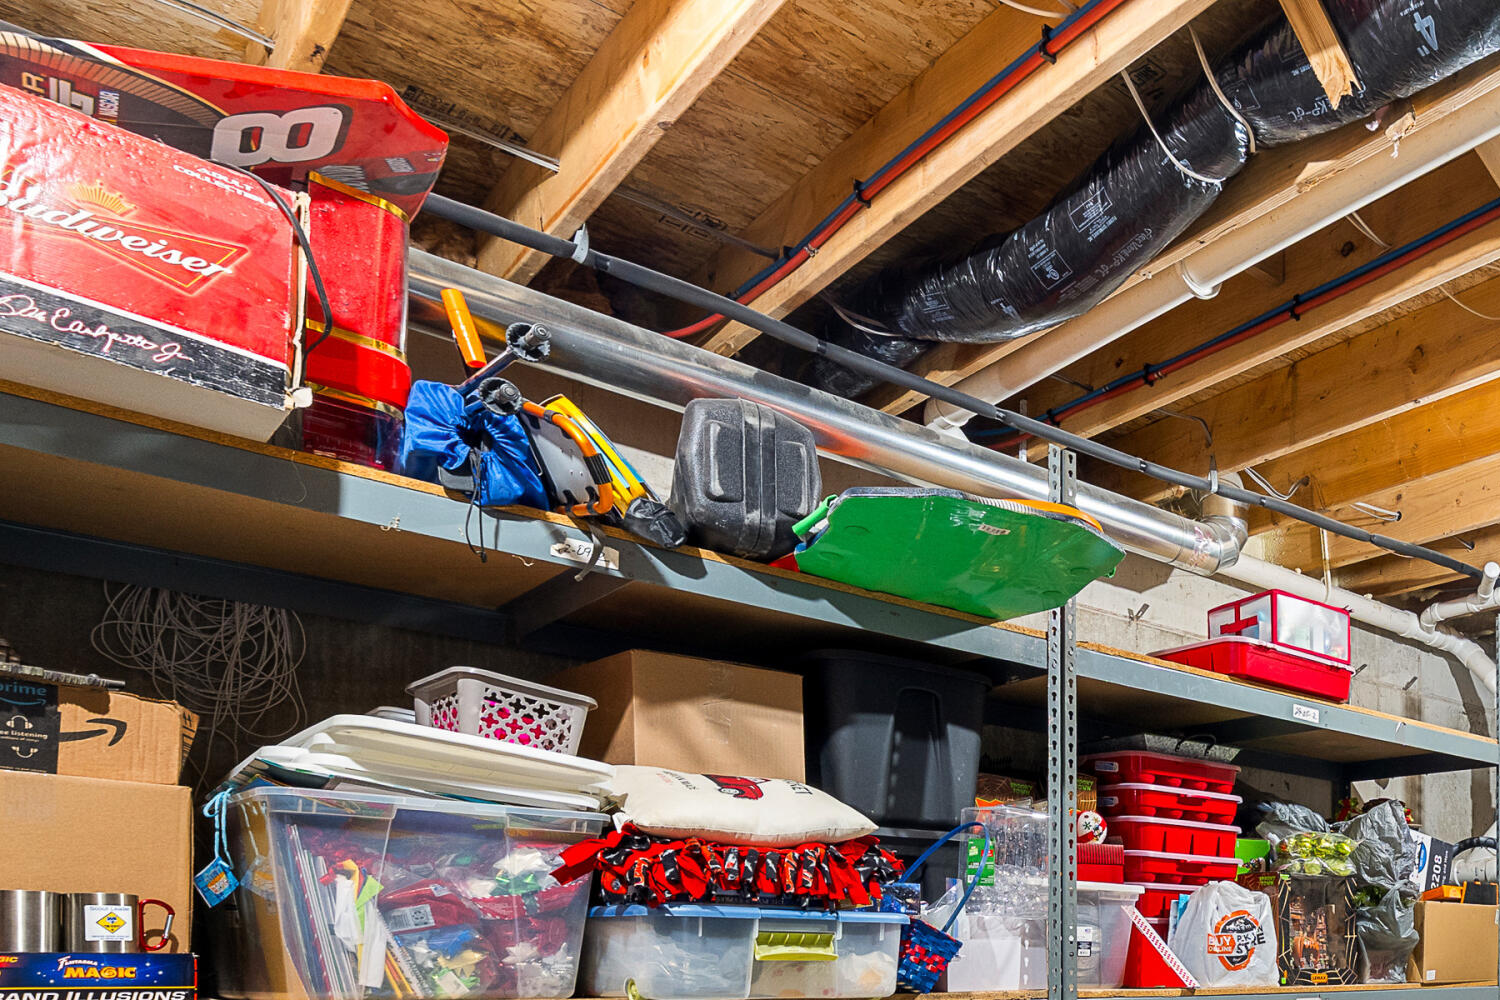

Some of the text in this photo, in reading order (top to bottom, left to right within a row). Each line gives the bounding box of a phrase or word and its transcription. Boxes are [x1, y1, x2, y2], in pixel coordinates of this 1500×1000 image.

[0, 172, 233, 276] Budweiser
[11, 729, 49, 741] listening
[1208, 935, 1232, 946] BUY
[63, 966, 137, 979] MAGIC
